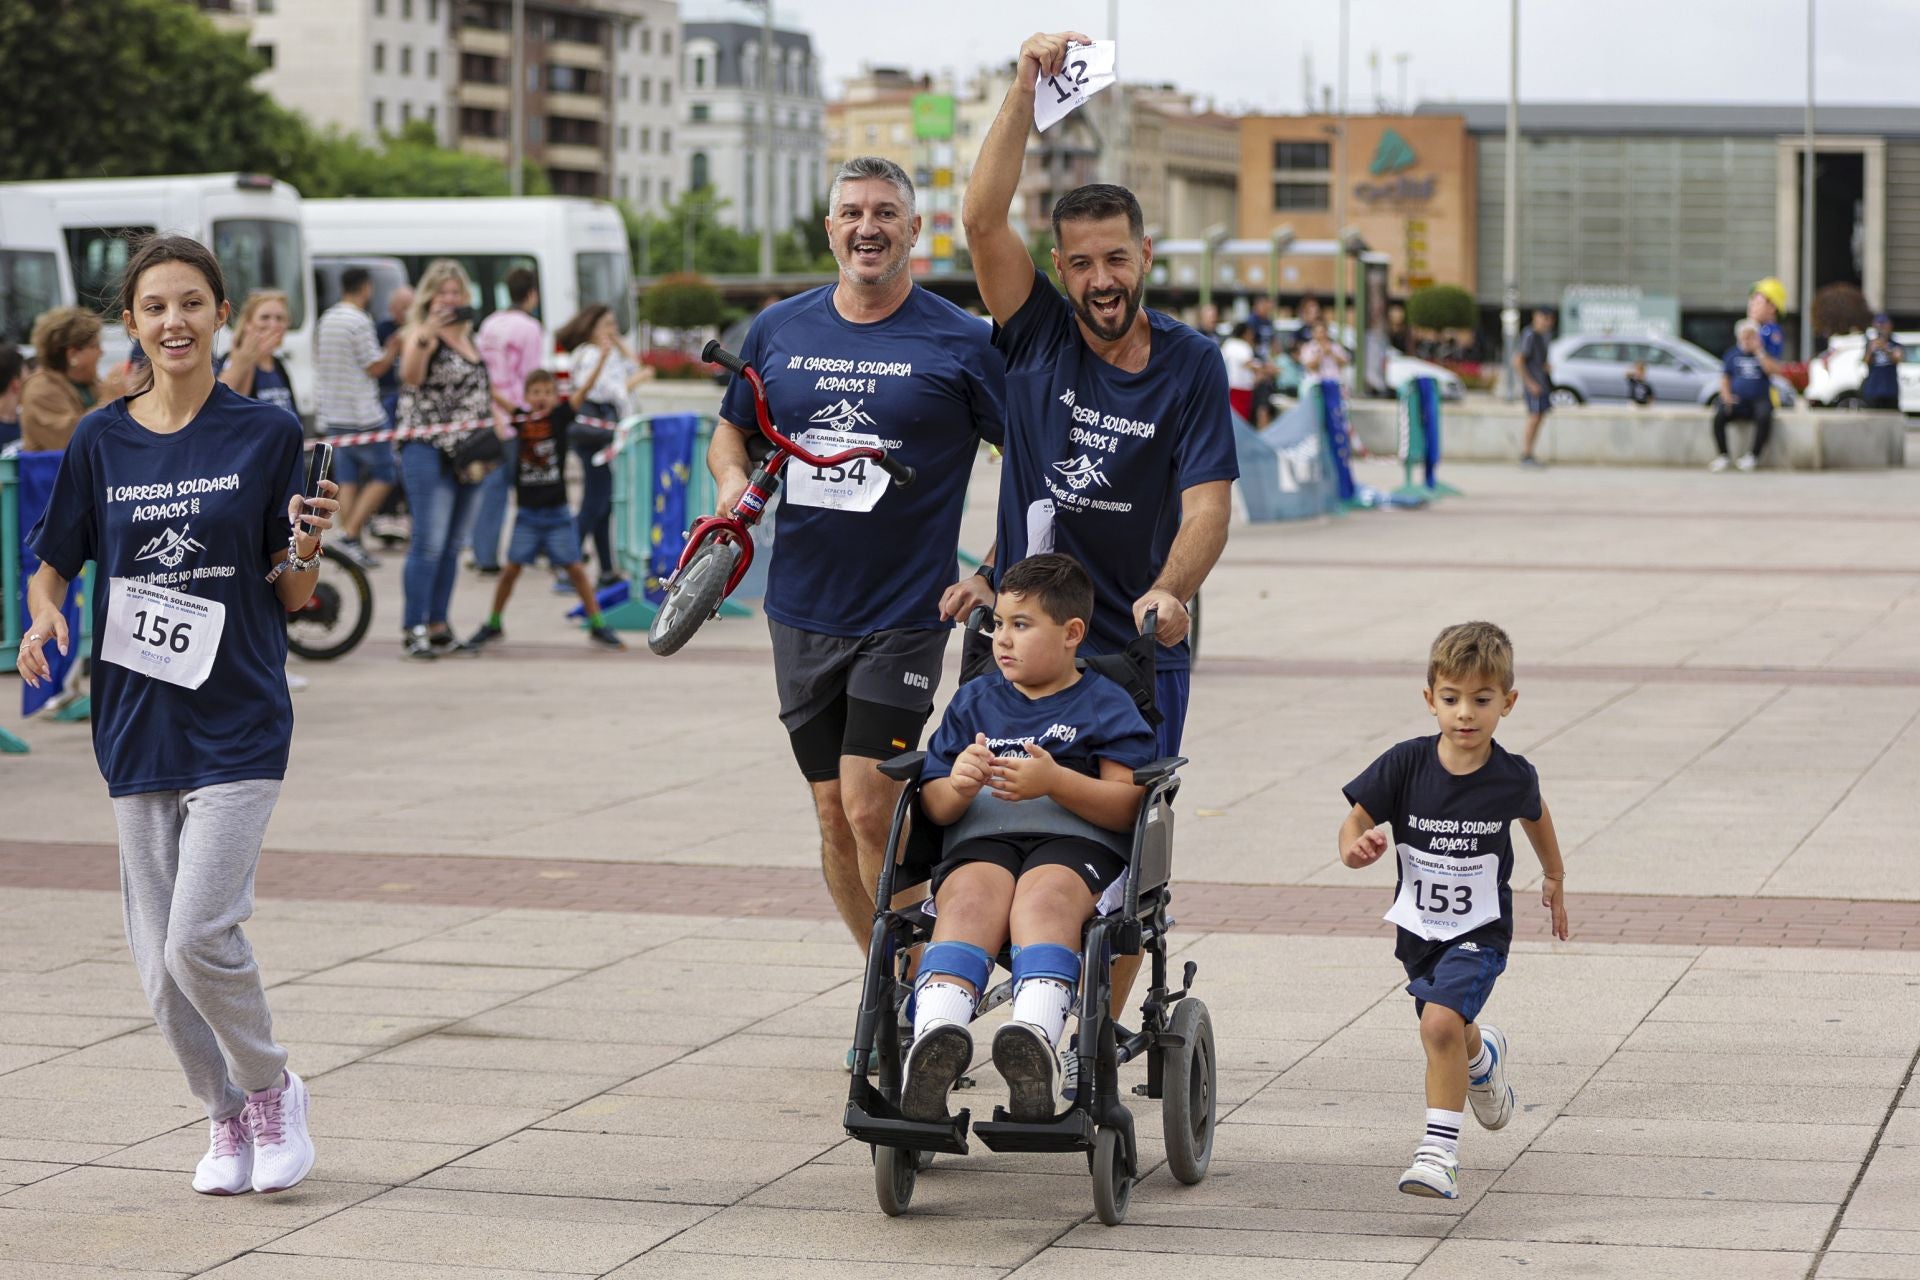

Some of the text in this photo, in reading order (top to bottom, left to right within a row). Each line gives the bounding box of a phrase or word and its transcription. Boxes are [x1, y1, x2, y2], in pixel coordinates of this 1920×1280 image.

[787, 356, 912, 377] XII CARRERA SOLIDARIA
[815, 376, 866, 393] ACPACYS
[1100, 414, 1155, 439] SOLIDARIA
[811, 455, 867, 485] 154
[115, 480, 173, 502] CARRERA
[177, 473, 239, 497] SOLIDARIA
[132, 501, 188, 522] ACPACYS
[1077, 497, 1090, 507] NO
[1091, 500, 1132, 512] INTENTARLO
[168, 575, 177, 584] ES
[179, 570, 191, 581] NO
[193, 566, 236, 579] INTENTARLO
[138, 588, 169, 602] CARRERA
[170, 597, 209, 613] SOLIDARIA
[132, 610, 192, 653] 156
[1418, 817, 1459, 834] CARRERA
[1461, 820, 1503, 835] SOLIDARIA
[1429, 837, 1470, 851] ACPACYS
[1415, 857, 1445, 870] CARRERA
[1446, 864, 1483, 872] SOLIDARIA
[1413, 879, 1473, 915] 153
[1422, 918, 1450, 927] ACPACYS
